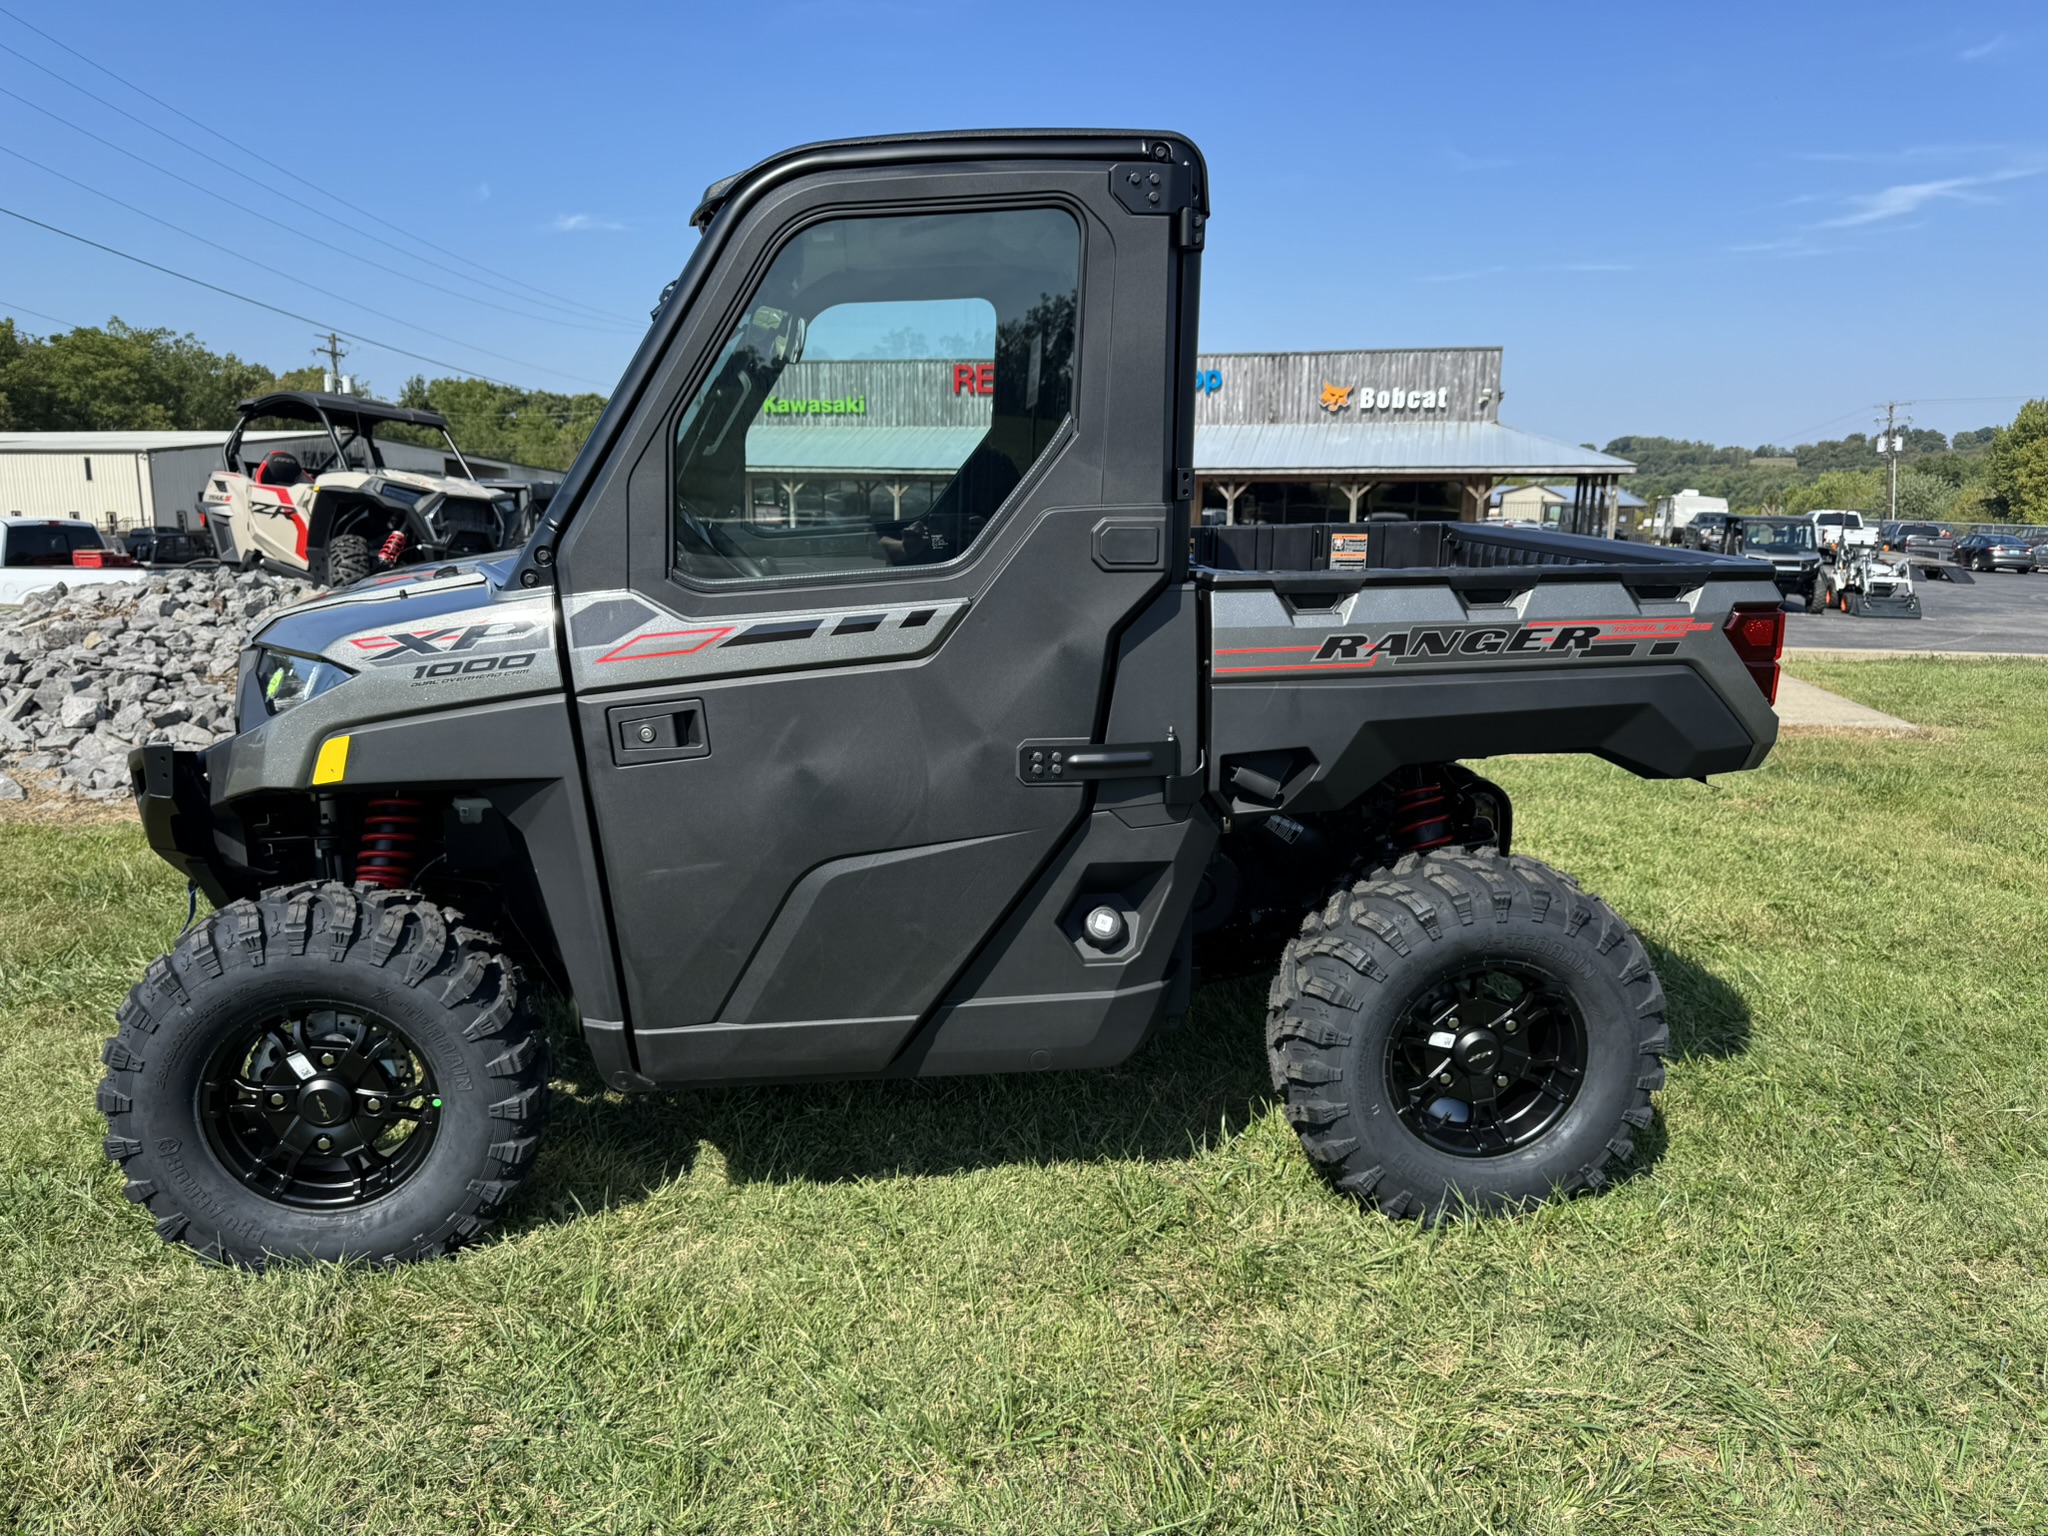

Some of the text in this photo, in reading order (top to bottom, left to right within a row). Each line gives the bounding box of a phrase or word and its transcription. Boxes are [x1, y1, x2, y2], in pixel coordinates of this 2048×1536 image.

[762, 395, 865, 414] Kawasaki
[1359, 386, 1448, 409] Bobcat
[1613, 622, 1714, 633] TRAIL BOSS
[361, 620, 536, 661] XP
[1311, 626, 1600, 662] RANGER
[413, 653, 536, 680] 1000
[441, 672, 502, 684] OVERHEAD
[504, 669, 530, 677] CAM
[370, 986, 473, 1091] X-TERRAIN
